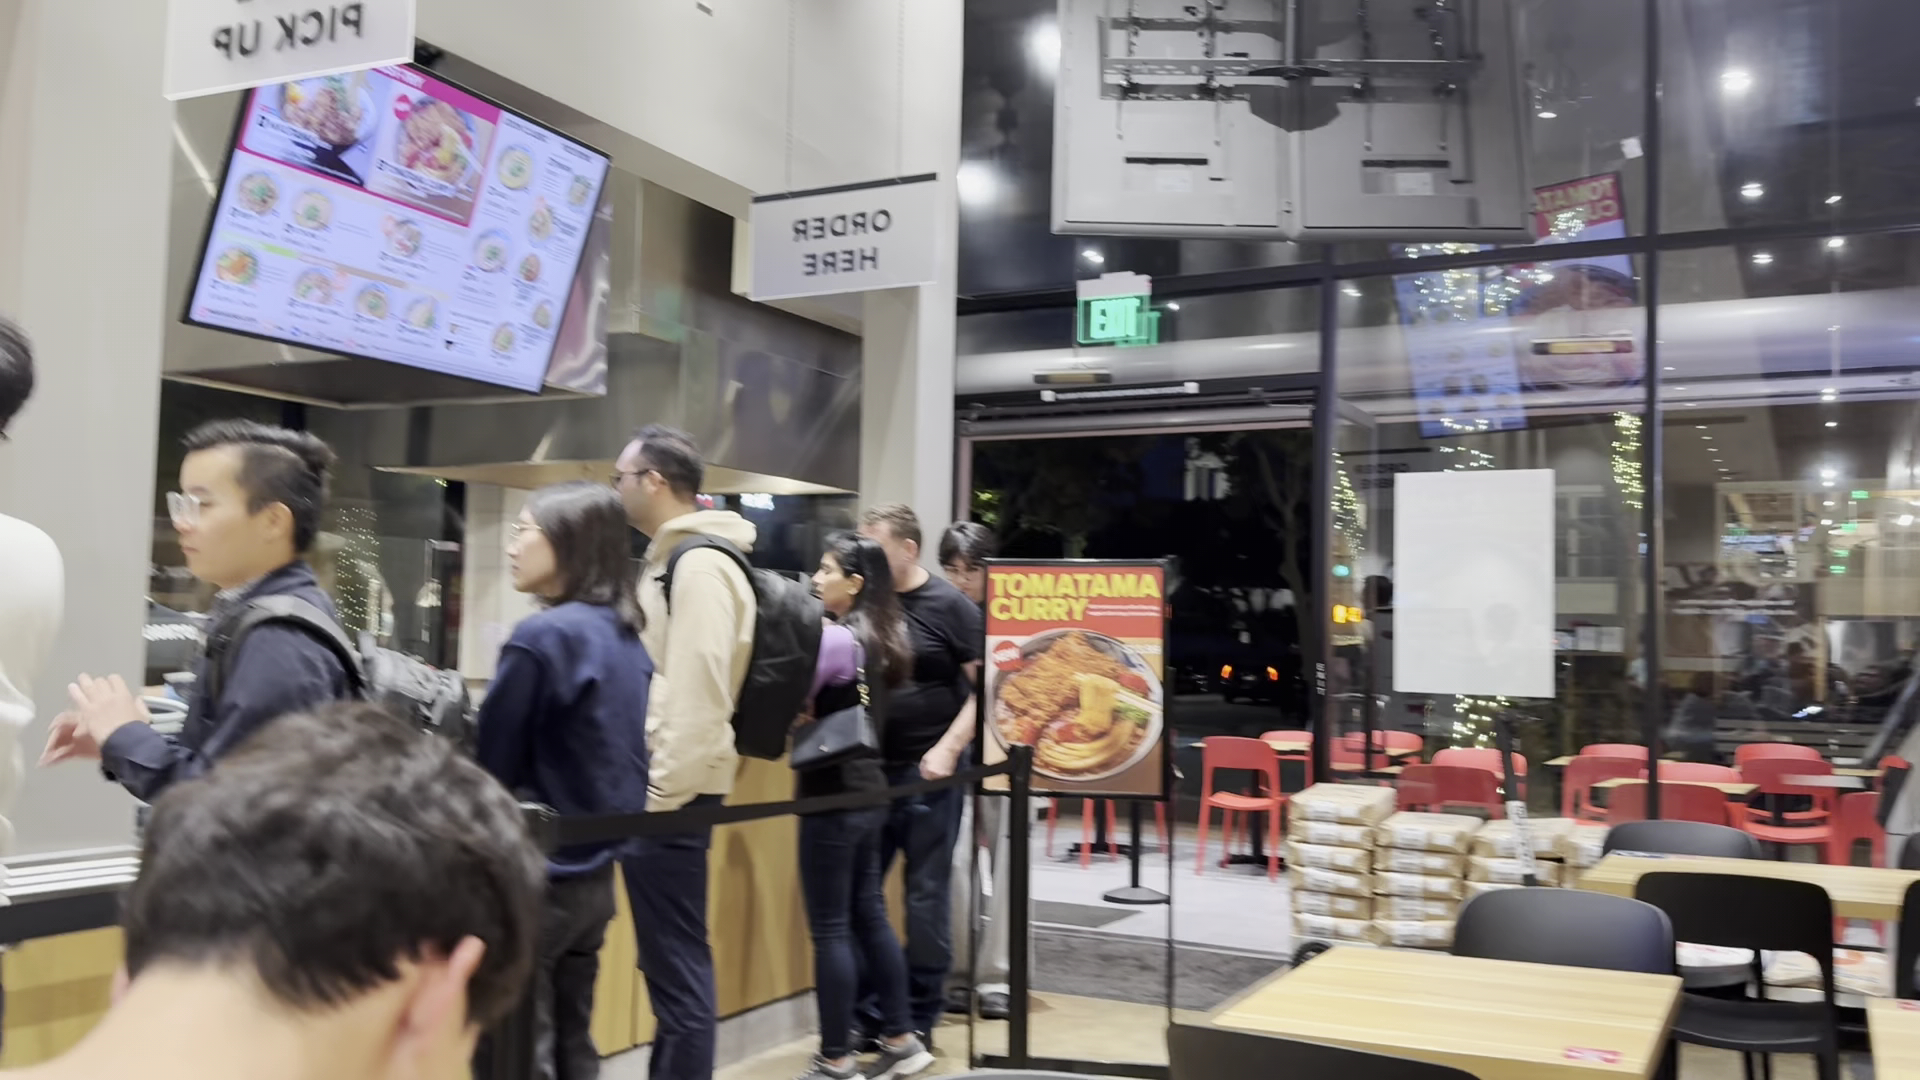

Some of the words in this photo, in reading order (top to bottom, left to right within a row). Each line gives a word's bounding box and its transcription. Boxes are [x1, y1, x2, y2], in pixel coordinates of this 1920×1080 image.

[1090, 298, 1141, 339] EXIT
[989, 573, 1161, 598] TOMATAMA
[989, 597, 1089, 621] CURRY
